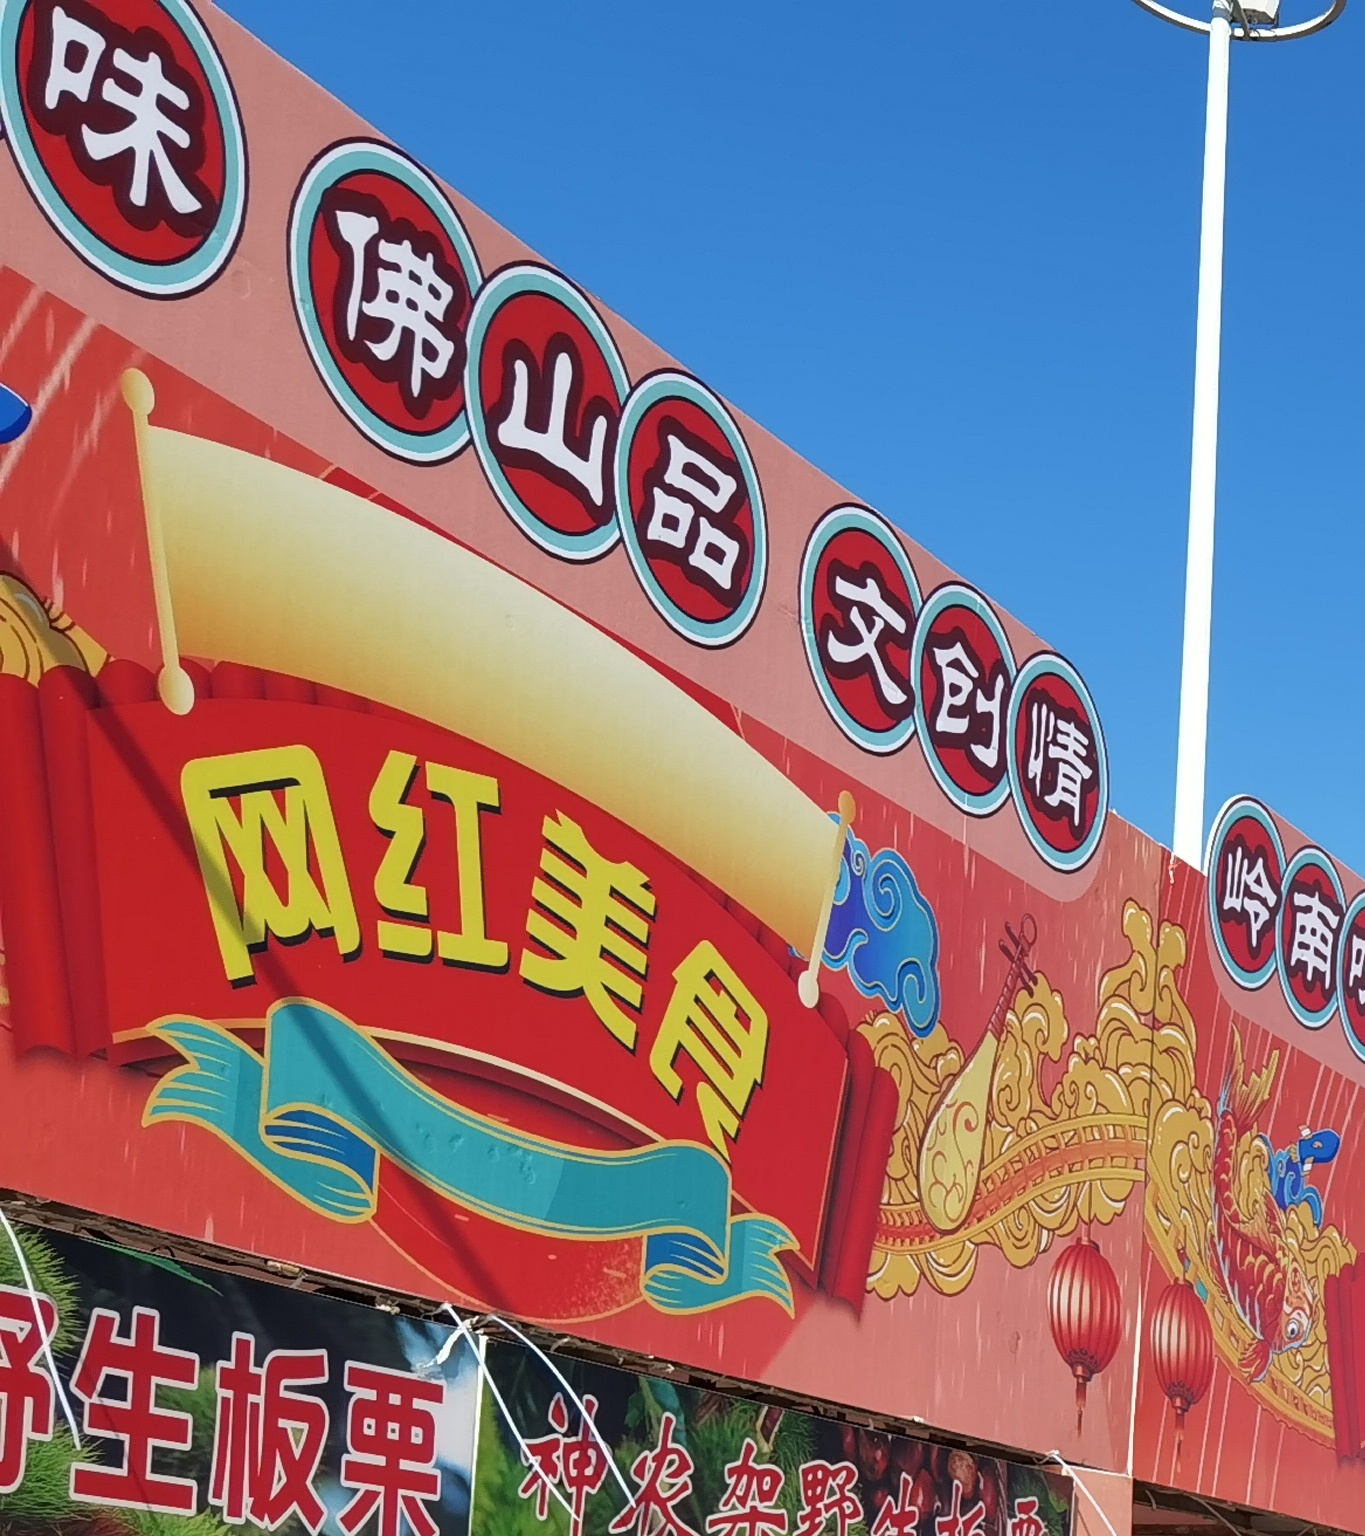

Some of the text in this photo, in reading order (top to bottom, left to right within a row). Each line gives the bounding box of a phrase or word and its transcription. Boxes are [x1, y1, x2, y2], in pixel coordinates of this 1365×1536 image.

[44, 4, 1095, 828] 味 佛山品 文创情
[180, 743, 769, 1164] 网红美食
